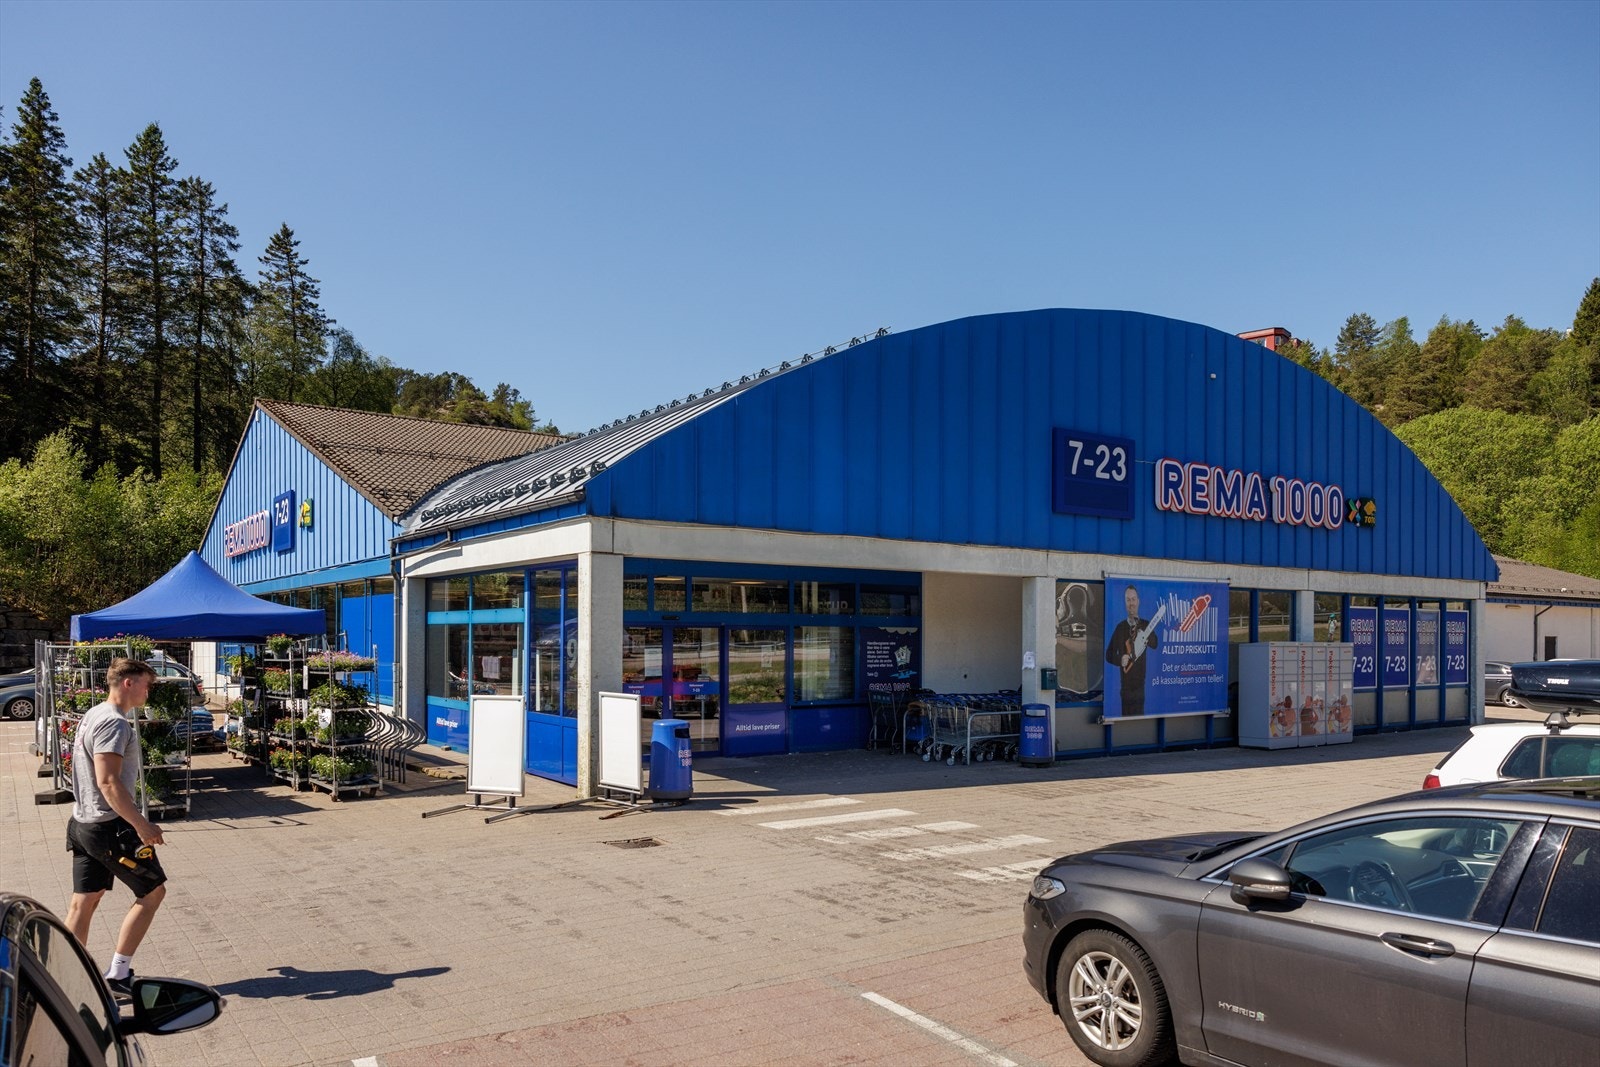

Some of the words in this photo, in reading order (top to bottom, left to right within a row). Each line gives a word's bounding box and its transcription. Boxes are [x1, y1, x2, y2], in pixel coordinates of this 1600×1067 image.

[1069, 440, 1127, 481] 7-23
[1155, 457, 1267, 522] REMA
[1269, 475, 1344, 530] 1000
[275, 498, 289, 527] 7-23
[225, 520, 245, 558] REMA
[245, 510, 268, 550] 1000
[1351, 619, 1374, 632] REMA
[1384, 619, 1407, 632] REMA
[1416, 620, 1437, 633] REMA
[1446, 621, 1466, 633] REMA
[1353, 632, 1372, 645] 1000
[1387, 632, 1405, 645] 1000
[1418, 633, 1436, 645] 1000
[1448, 633, 1464, 645] 1000
[1162, 645, 1185, 655] ALLTID
[1185, 644, 1217, 654] PRISKUTT!
[1162, 663, 1174, 672] Det
[1180, 662, 1215, 672] sluttsummen
[1352, 656, 1374, 673] 7-23
[1385, 655, 1407, 672] 7-23
[1417, 655, 1436, 671] 7-23
[1447, 655, 1465, 670] 7-23
[1152, 676, 1160, 686] på
[1160, 676, 1194, 686] kassalappen
[1195, 676, 1206, 684] som
[1208, 674, 1224, 683] teller!
[764, 722, 780, 731] priser
[1218, 1000, 1256, 1019] HYBRID
